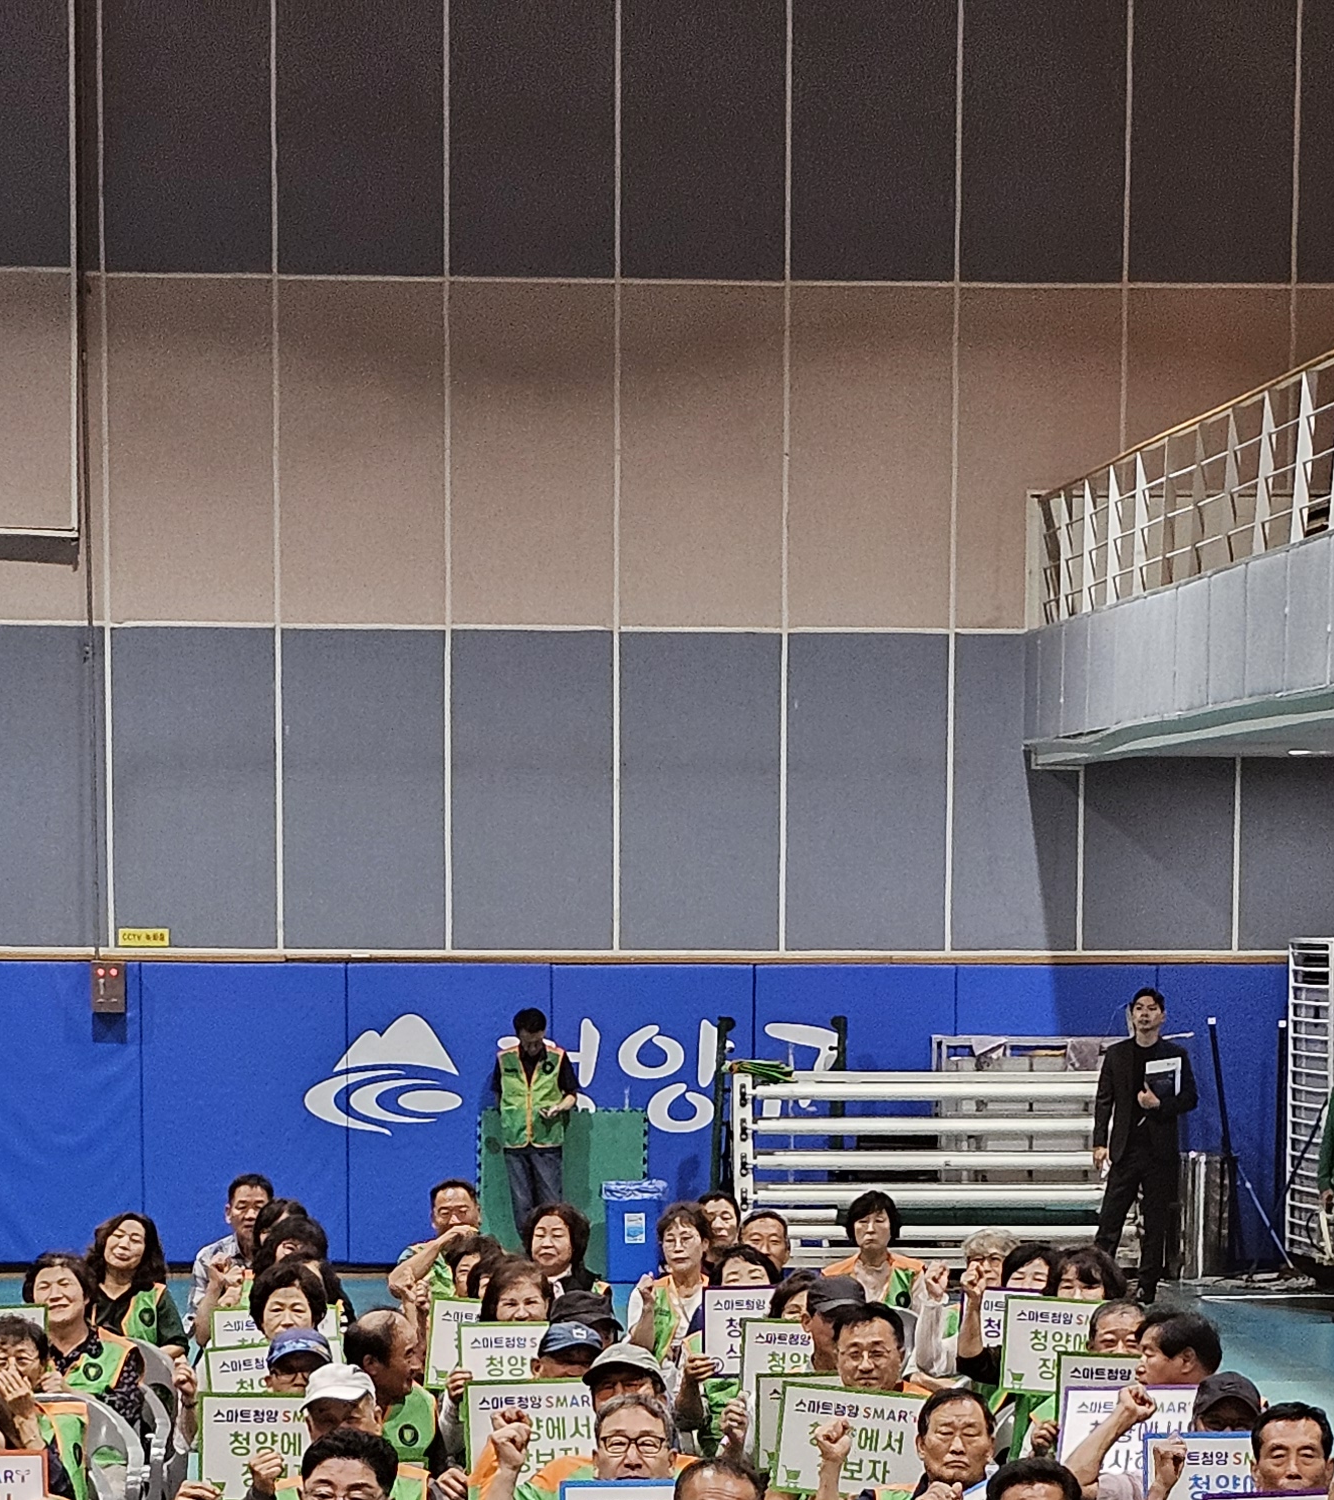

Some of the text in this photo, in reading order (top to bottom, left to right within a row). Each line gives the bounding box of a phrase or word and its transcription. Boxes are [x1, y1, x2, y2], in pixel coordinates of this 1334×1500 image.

[122, 932, 142, 941] CCTV
[213, 1408, 278, 1423] 스마트청양
[229, 1430, 301, 1457] 청양에
[1185, 1450, 1229, 1467] 트청양
